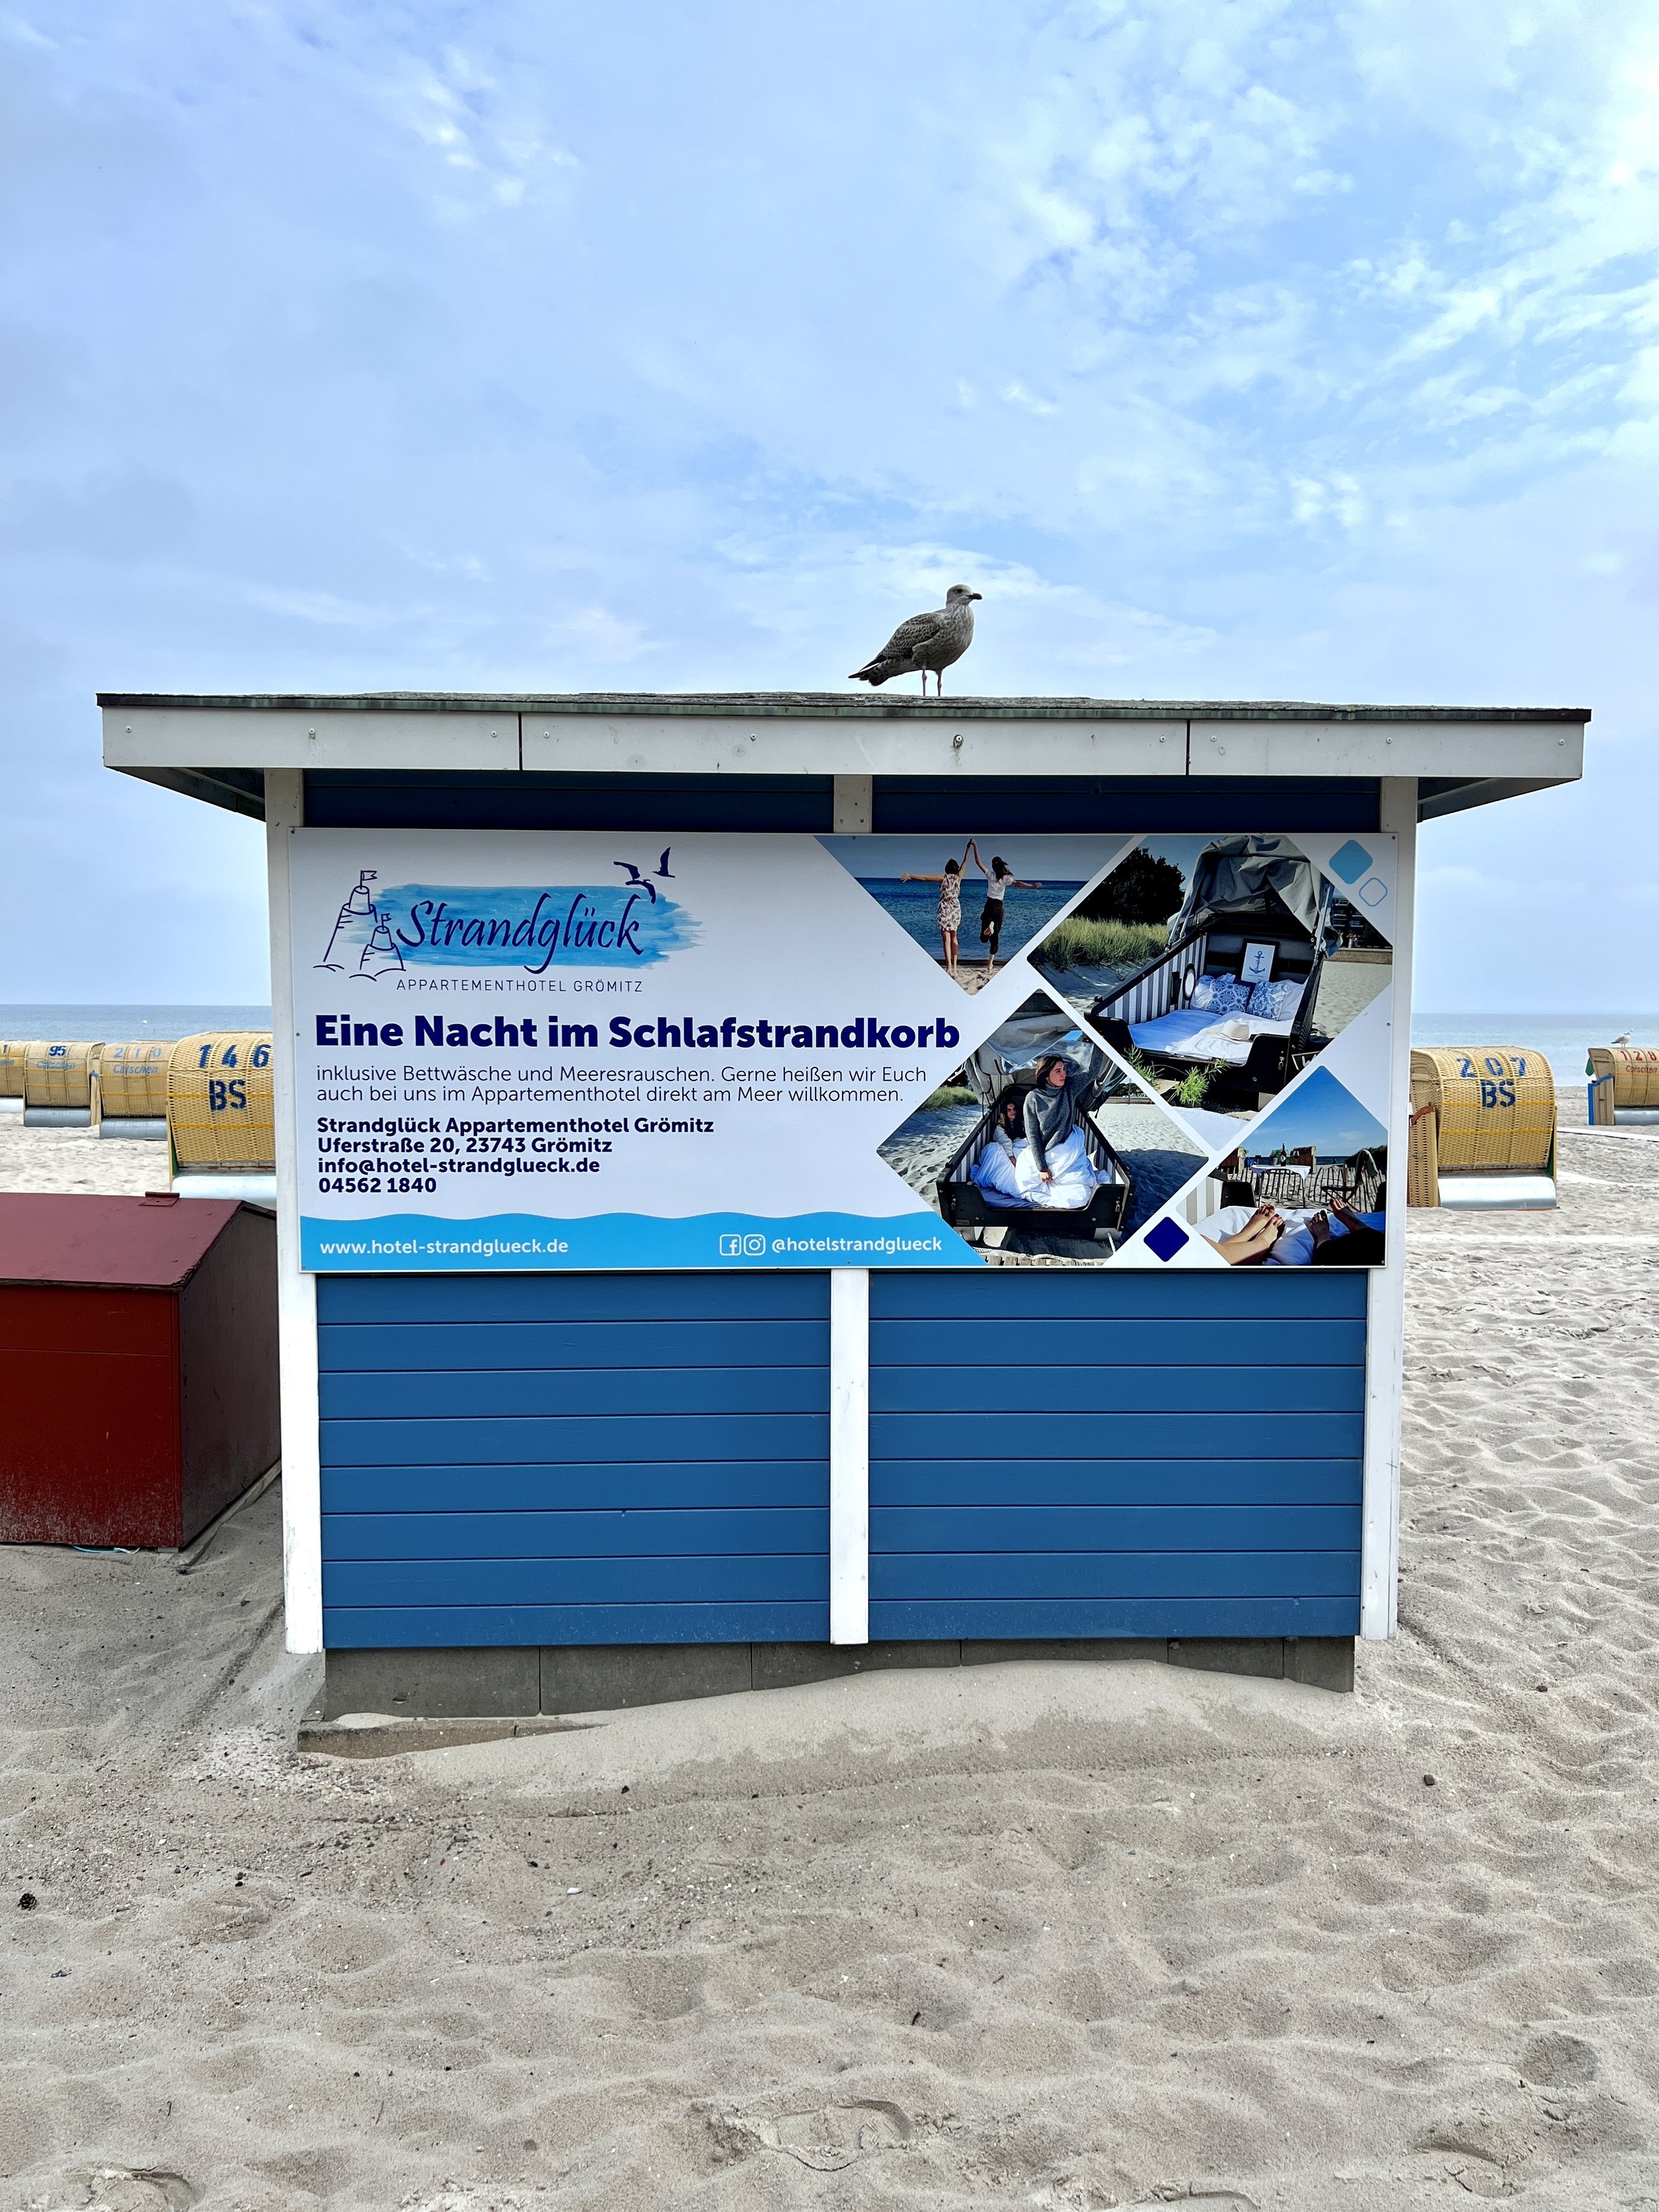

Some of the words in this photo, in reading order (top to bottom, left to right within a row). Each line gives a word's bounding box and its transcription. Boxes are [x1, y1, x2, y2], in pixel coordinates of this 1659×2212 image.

[396, 893, 644, 974] Strandglück
[396, 978, 567, 992] APPARTEMENTHOTEL
[573, 979, 642, 993] GRÖMITZ
[315, 1015, 403, 1047] Eine
[415, 1015, 538, 1048] Nacht
[548, 1015, 599, 1048] im
[609, 1016, 960, 1049] Schlafstrandkorb
[49, 1045, 66, 1057] 95
[199, 1044, 272, 1068] 146
[317, 1065, 396, 1082] inklusive
[403, 1066, 512, 1082] Bettwäsche
[518, 1066, 553, 1082] und
[560, 1067, 715, 1082] Meeresrauschen.
[721, 1067, 776, 1082] Gerne
[783, 1067, 843, 1082] heißen
[848, 1067, 877, 1082] wir
[883, 1067, 926, 1082] Euch
[1457, 1057, 1526, 1078] 207
[209, 1079, 246, 1111] BS
[317, 1086, 363, 1102] auch
[370, 1086, 397, 1102] bei
[403, 1090, 437, 1102] uns
[443, 1087, 465, 1102] im
[471, 1086, 641, 1105] Appartementhotel
[646, 1086, 697, 1102] direkt
[703, 1090, 731, 1102] am
[738, 1088, 783, 1102] Meer
[788, 1086, 903, 1102] willkommen.
[1480, 1079, 1516, 1108] BS
[317, 1117, 441, 1136] Strandglück
[445, 1118, 630, 1137] Appartementhotel
[634, 1118, 714, 1134] Grömitz
[318, 1138, 425, 1153] Uferstraße
[430, 1138, 461, 1155] 20,
[466, 1138, 526, 1153] 23743
[531, 1138, 613, 1153] Grömitz
[318, 1157, 600, 1177] info@hotel-strandglueck.de
[319, 1177, 382, 1193] 04562
[387, 1177, 437, 1193] 1840
[320, 1238, 569, 1257] www.hotel-strandglueck.de
[771, 1236, 942, 1255] @hotelstrandglueck
